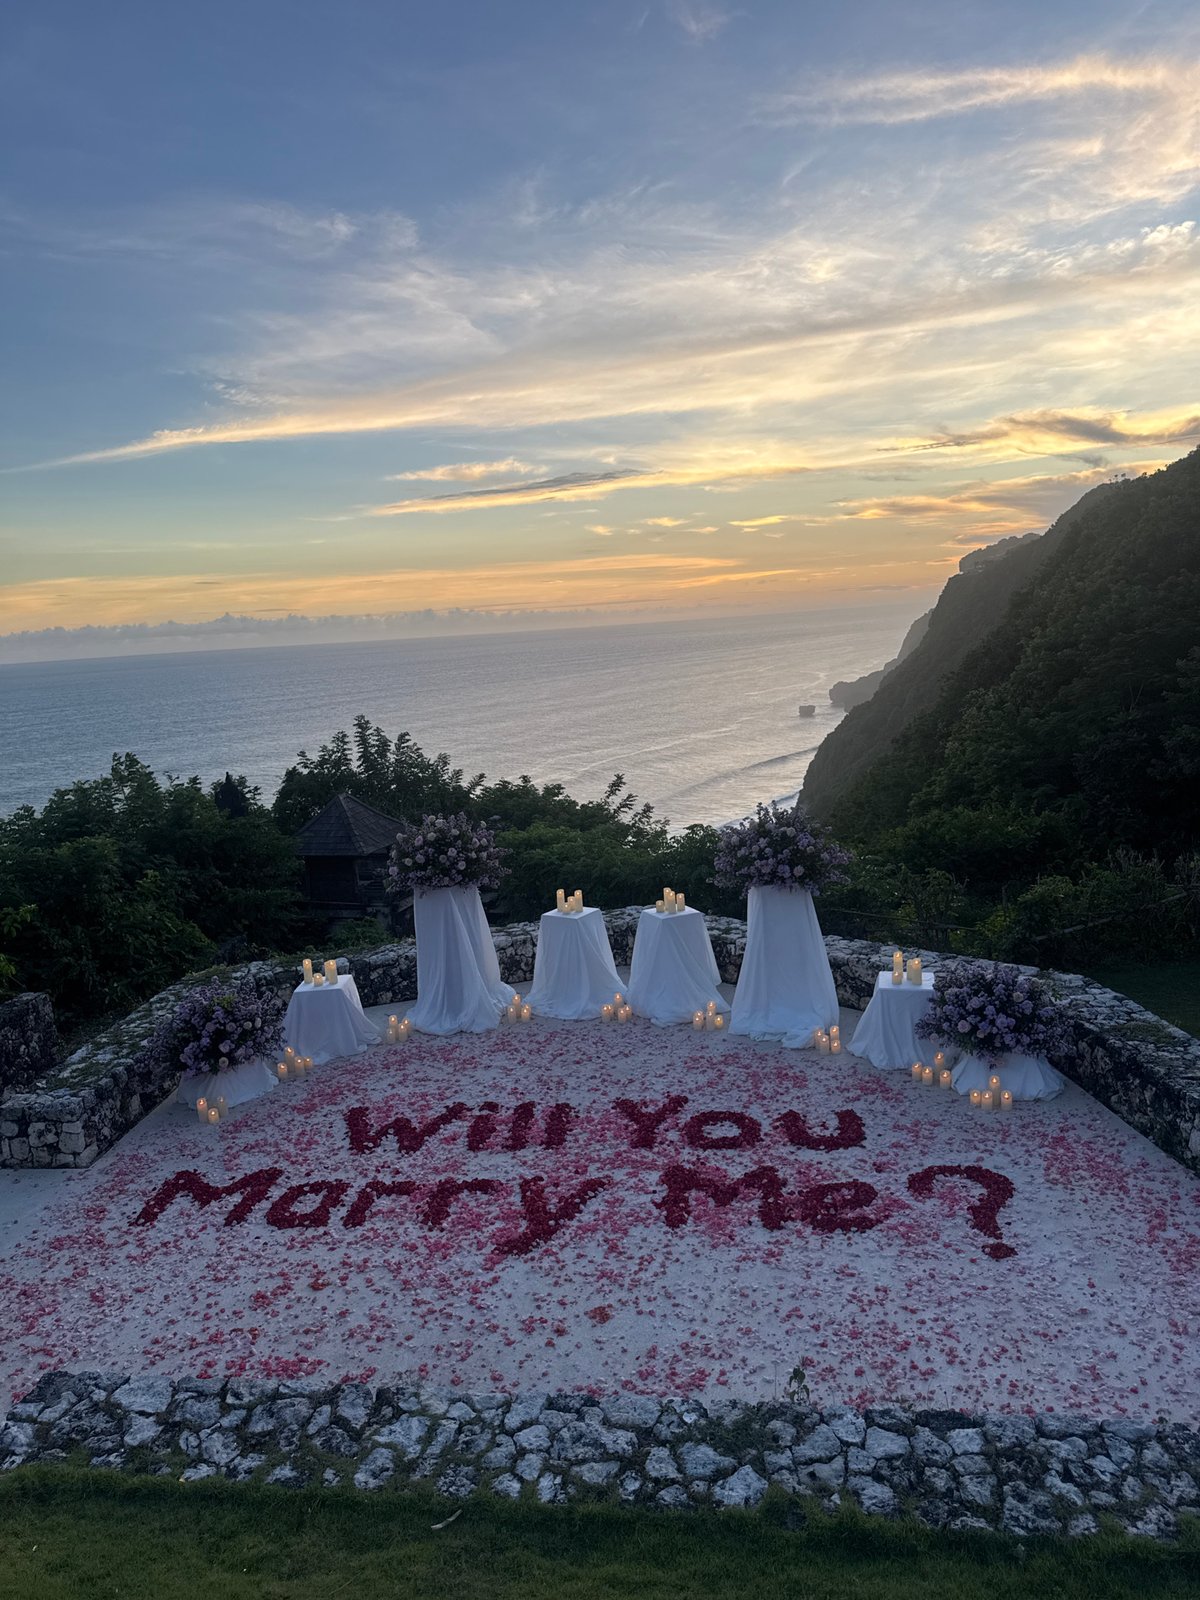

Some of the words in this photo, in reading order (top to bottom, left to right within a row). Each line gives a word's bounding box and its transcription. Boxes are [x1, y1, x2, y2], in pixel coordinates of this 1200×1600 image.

[343, 1100, 576, 1154] Will
[612, 1094, 866, 1151] You
[129, 1167, 609, 1255] Marry
